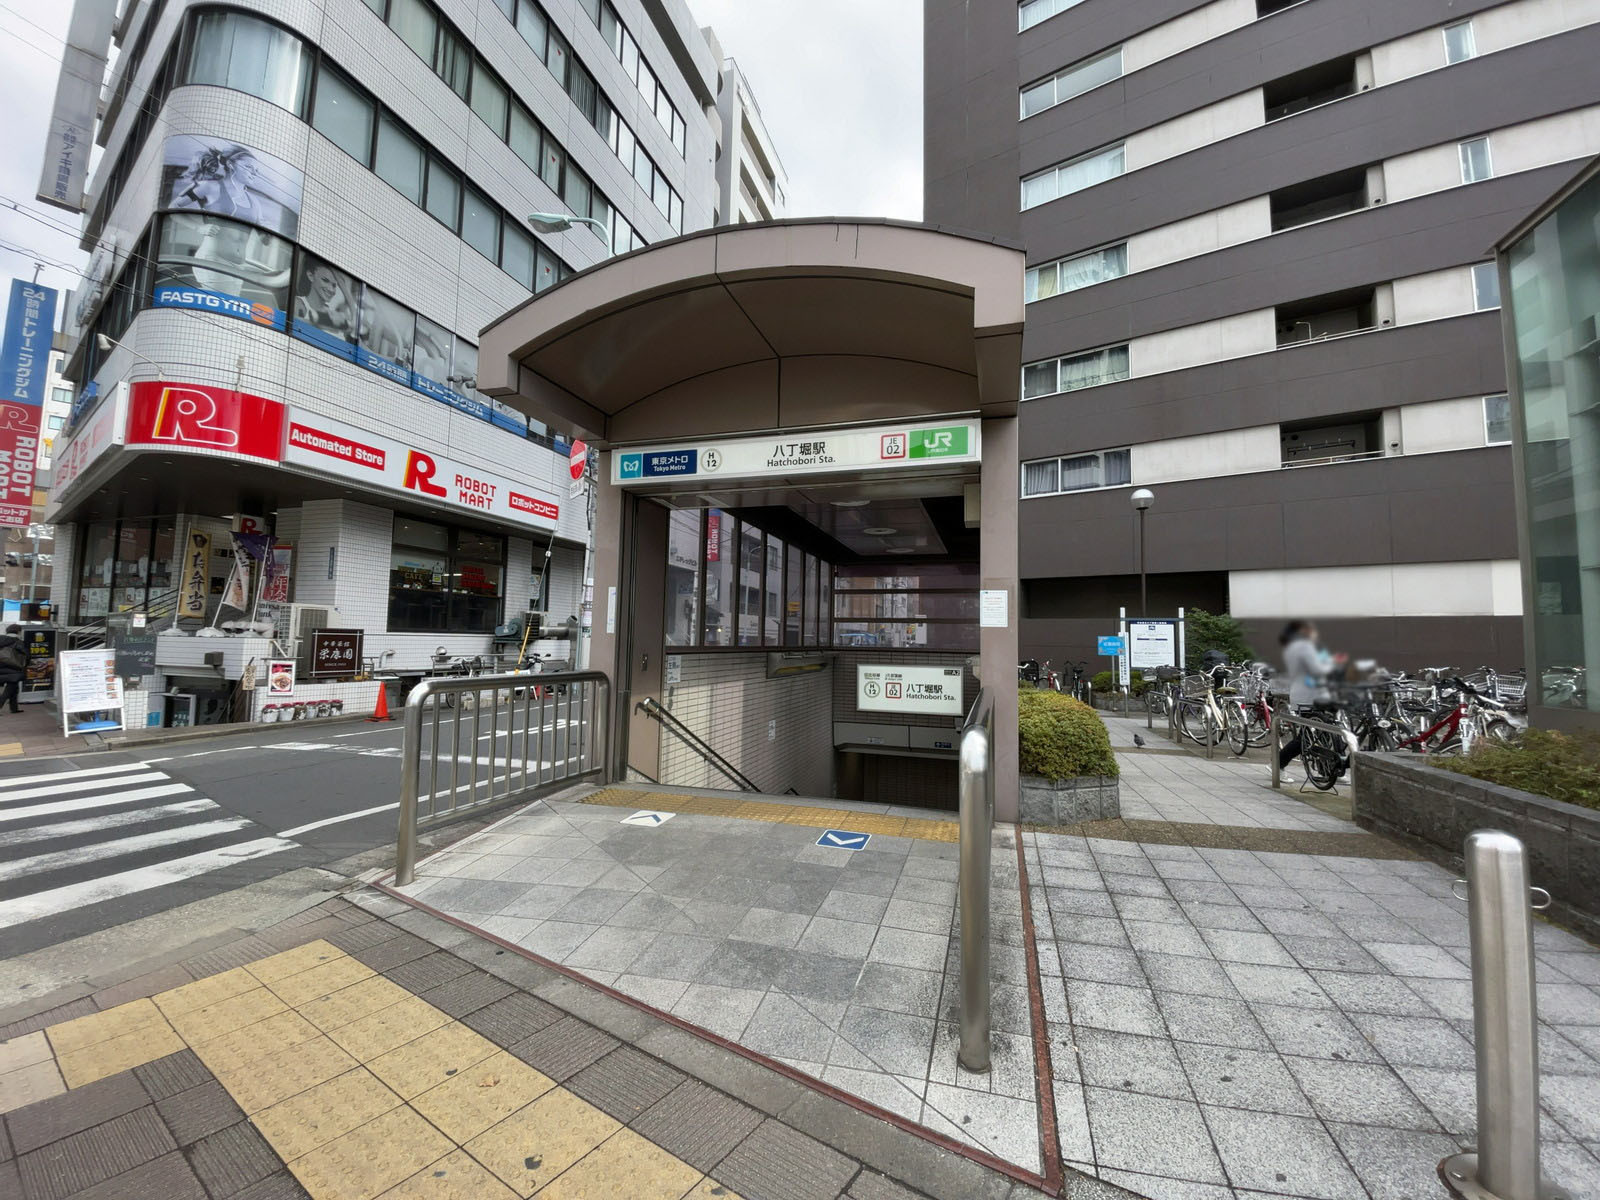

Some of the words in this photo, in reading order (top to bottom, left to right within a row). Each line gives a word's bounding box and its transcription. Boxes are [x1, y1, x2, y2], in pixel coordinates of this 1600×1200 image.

[291, 428, 352, 457] Automated
[355, 448, 383, 466] Store
[888, 437, 898, 445] JE
[924, 432, 953, 449] JR
[772, 441, 826, 458] 八丁堀駅
[886, 444, 900, 455] 02
[10, 435, 36, 496] ROBOT
[651, 455, 688, 466] 東京メトロ
[706, 459, 717, 467] 12
[767, 455, 817, 468] Hatchobori
[819, 454, 836, 464] Sta.
[654, 465, 669, 473] Tokyo
[670, 464, 686, 472] Metro
[455, 473, 497, 498] ROBOT
[459, 491, 493, 510] MART
[511, 496, 557, 517] ロボットコンビニ
[906, 683, 943, 693] 八丁堀駅
